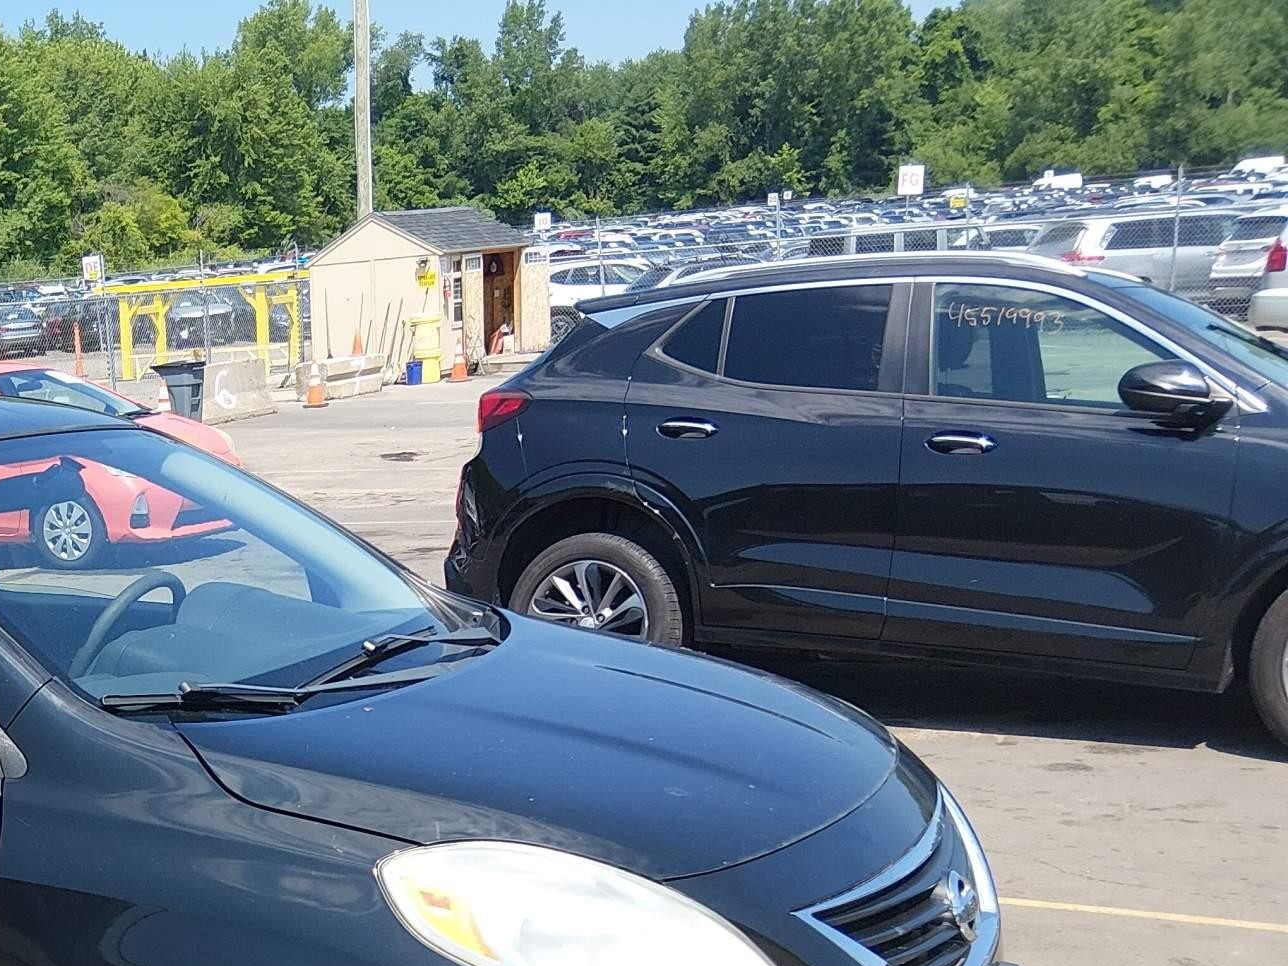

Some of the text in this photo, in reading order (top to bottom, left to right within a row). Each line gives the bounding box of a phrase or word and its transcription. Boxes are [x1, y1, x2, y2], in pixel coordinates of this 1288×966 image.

[901, 173, 919, 187] FG
[948, 301, 1065, 336] 45519993
[214, 369, 236, 409] 6
